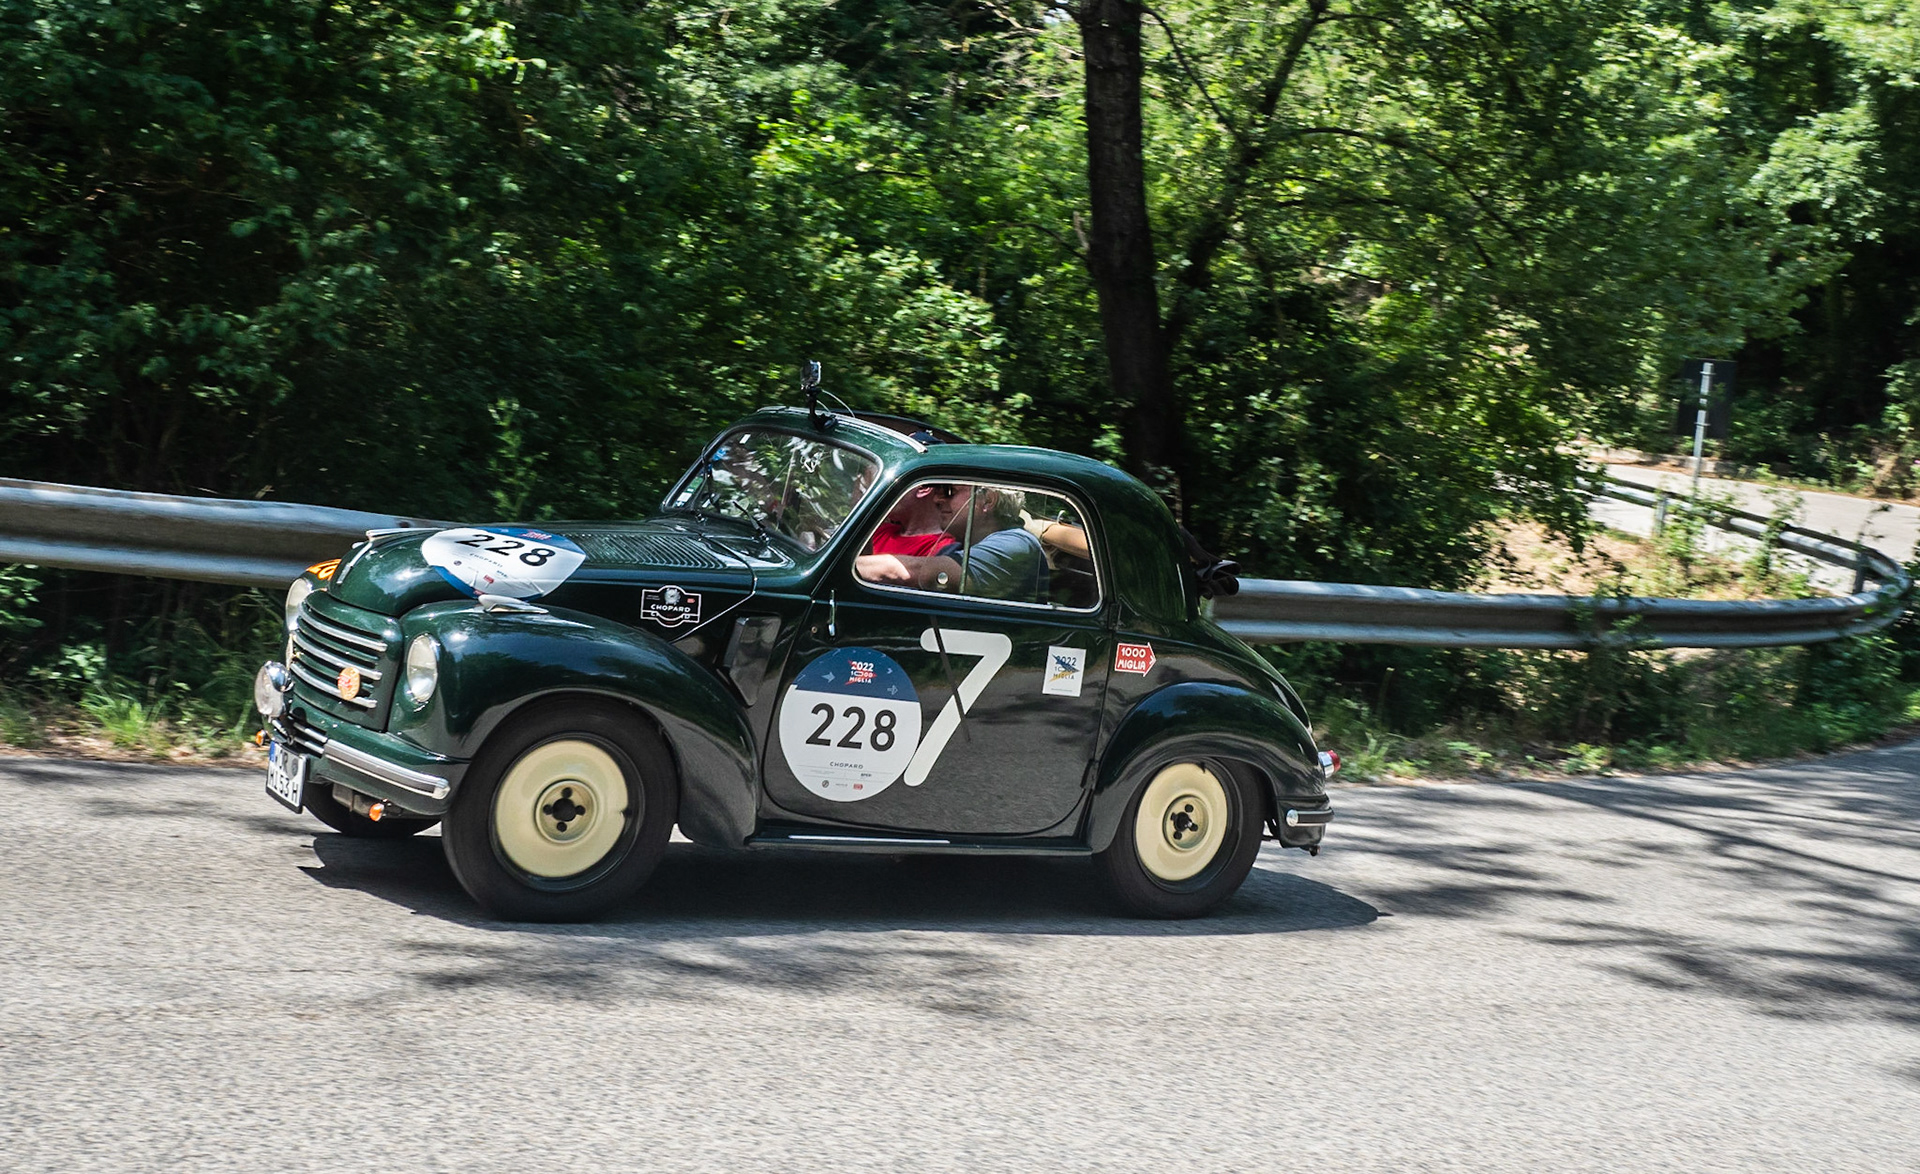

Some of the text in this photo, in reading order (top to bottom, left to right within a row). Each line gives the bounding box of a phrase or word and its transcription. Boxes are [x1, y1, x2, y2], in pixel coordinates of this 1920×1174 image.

[456, 534, 556, 567] 228
[650, 603, 691, 613] CHOPARD
[1121, 647, 1146, 658] 1000
[851, 661, 874, 671] 2022
[1055, 655, 1077, 667] 2022
[1117, 659, 1146, 670] MIGLIA
[849, 676, 872, 684] MIGLIA
[805, 703, 897, 752] 228
[829, 761, 864, 770] CHOPARD
